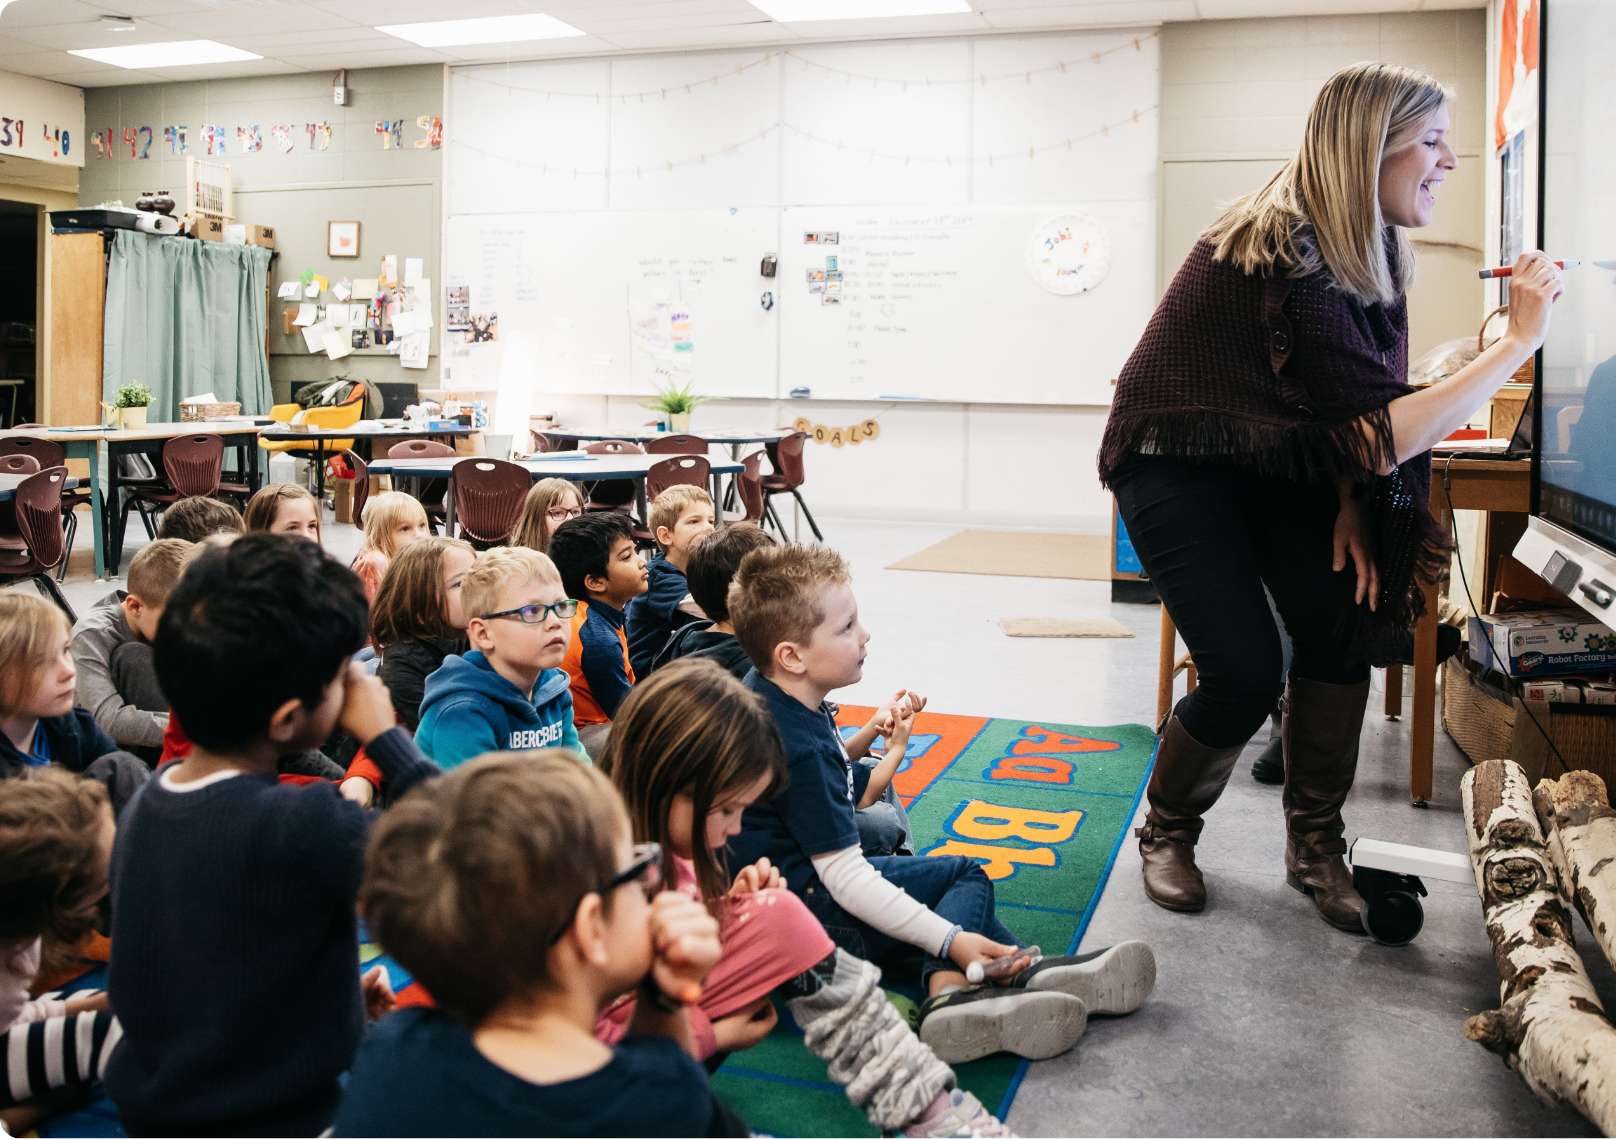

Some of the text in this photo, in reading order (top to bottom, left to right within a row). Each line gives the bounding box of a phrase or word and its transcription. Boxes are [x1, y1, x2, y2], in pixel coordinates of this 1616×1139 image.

[0, 117, 70, 157] 39 40
[121, 126, 153, 160] 42
[209, 221, 222, 233] 3M
[262, 227, 273, 239] 3M
[1548, 655, 1572, 664] Robot
[1574, 652, 1606, 662] Factory
